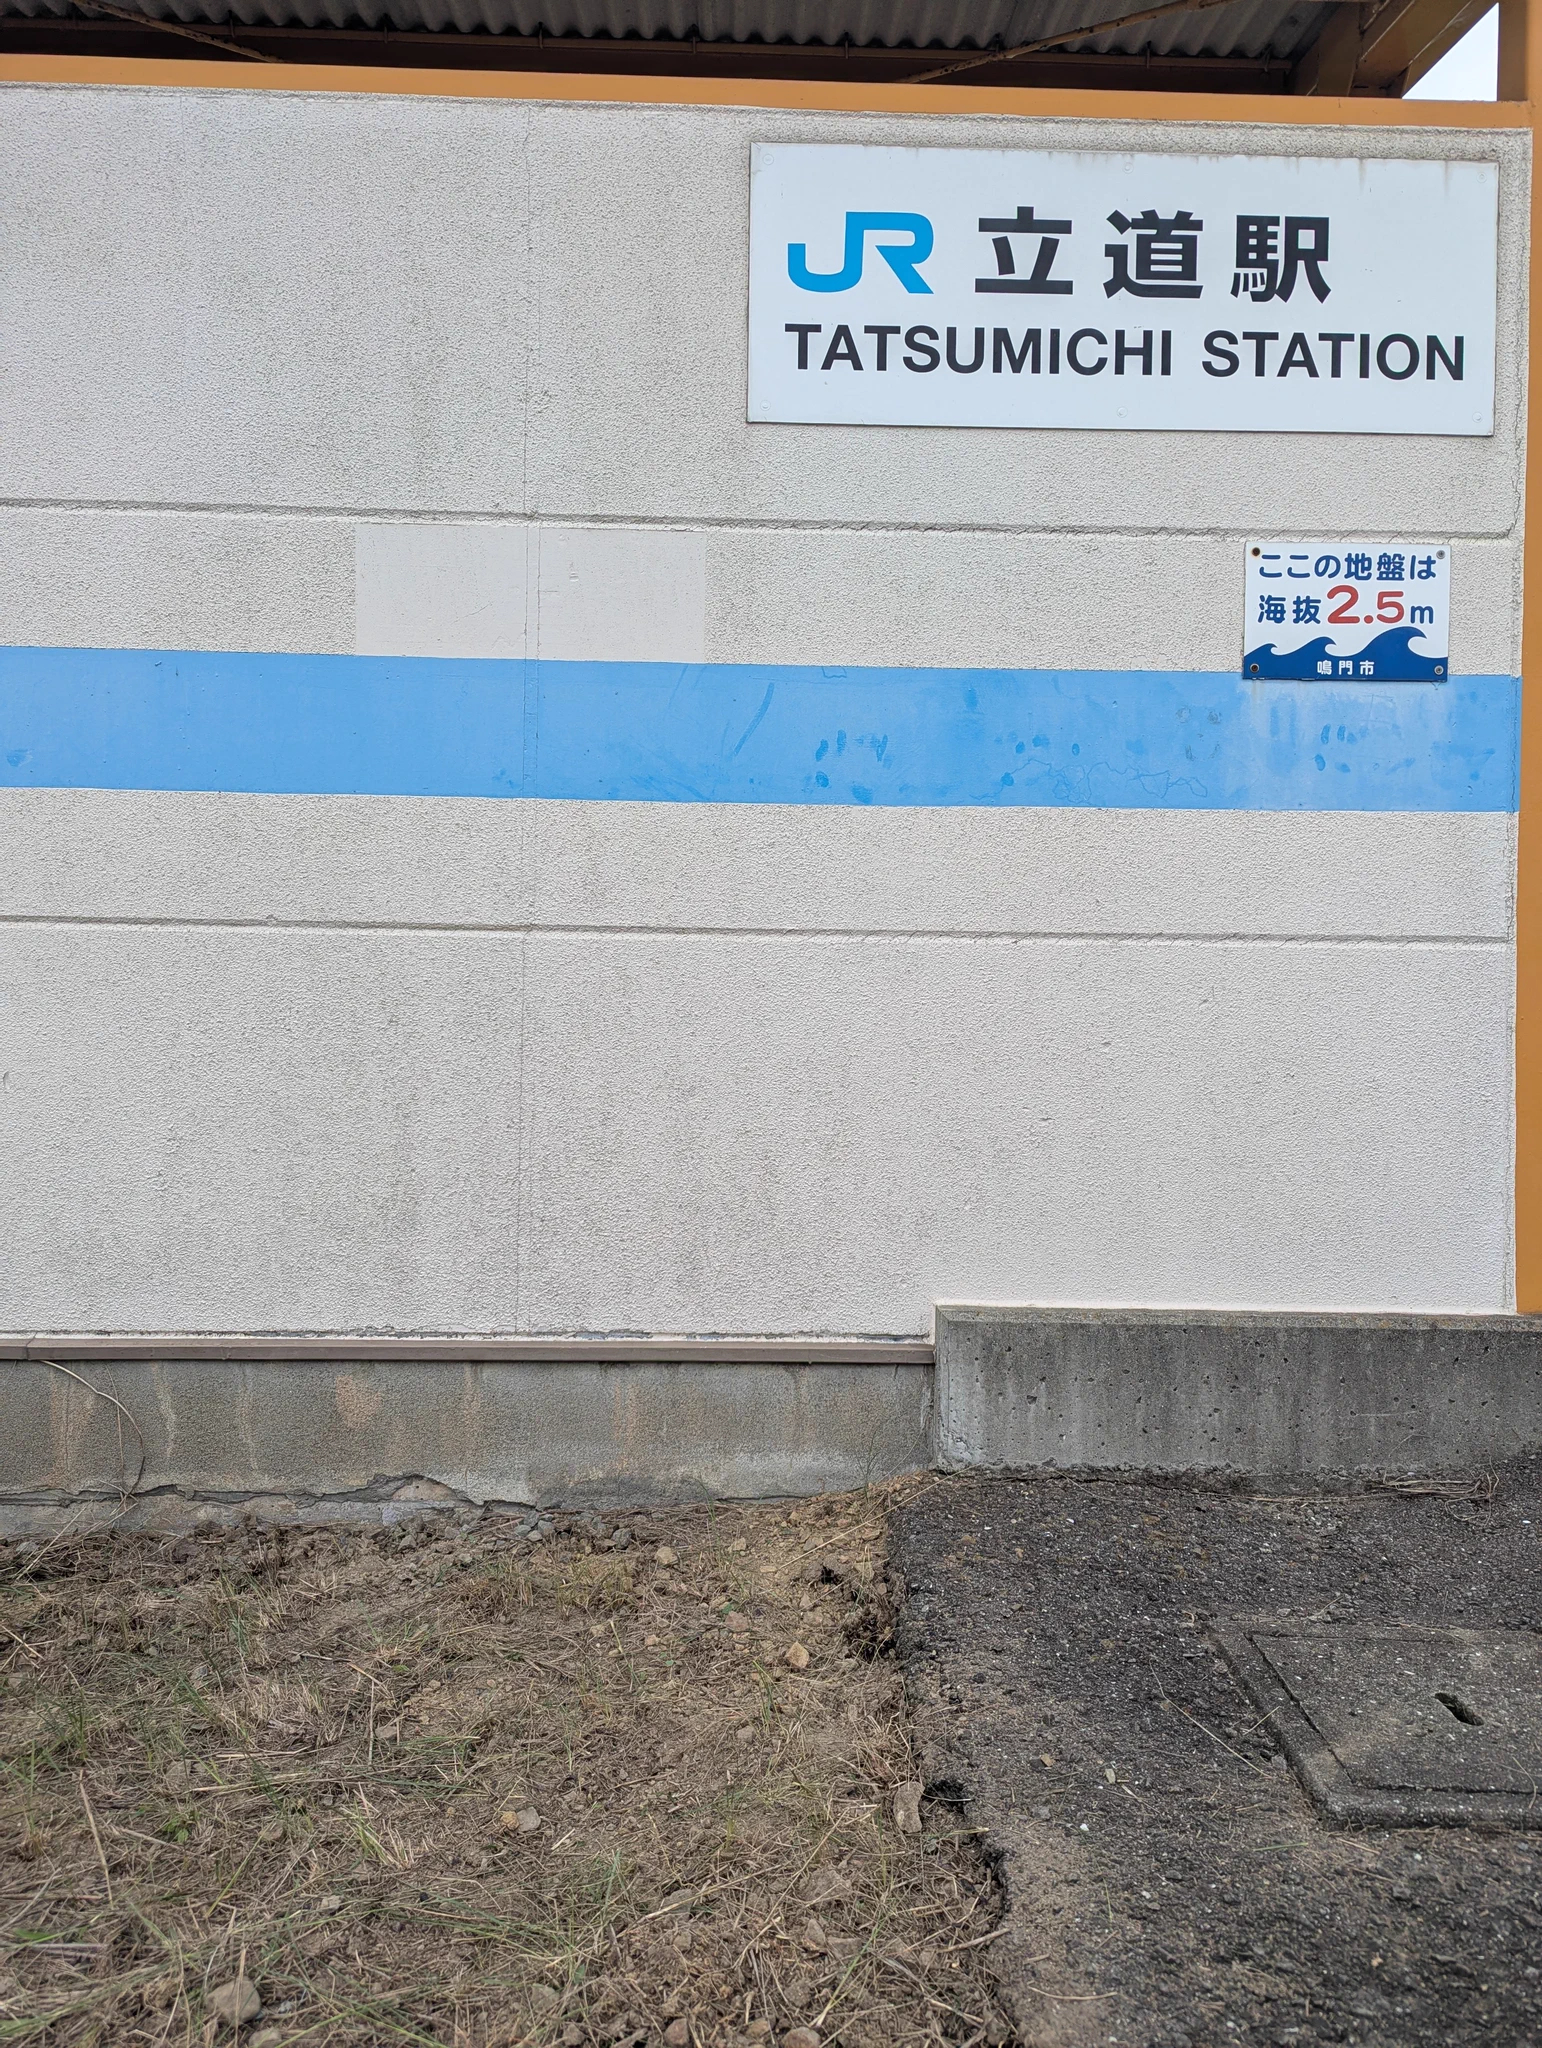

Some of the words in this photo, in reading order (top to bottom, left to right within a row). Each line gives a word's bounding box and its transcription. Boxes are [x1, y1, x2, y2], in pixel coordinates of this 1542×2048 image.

[787, 211, 935, 294] JR
[974, 205, 1332, 304] 立道駅
[784, 323, 1172, 376] TATSUMICHI
[1201, 331, 1465, 381] STATION
[1259, 552, 1437, 581] ここの地盤は
[1317, 660, 1375, 675] 鳴門市
